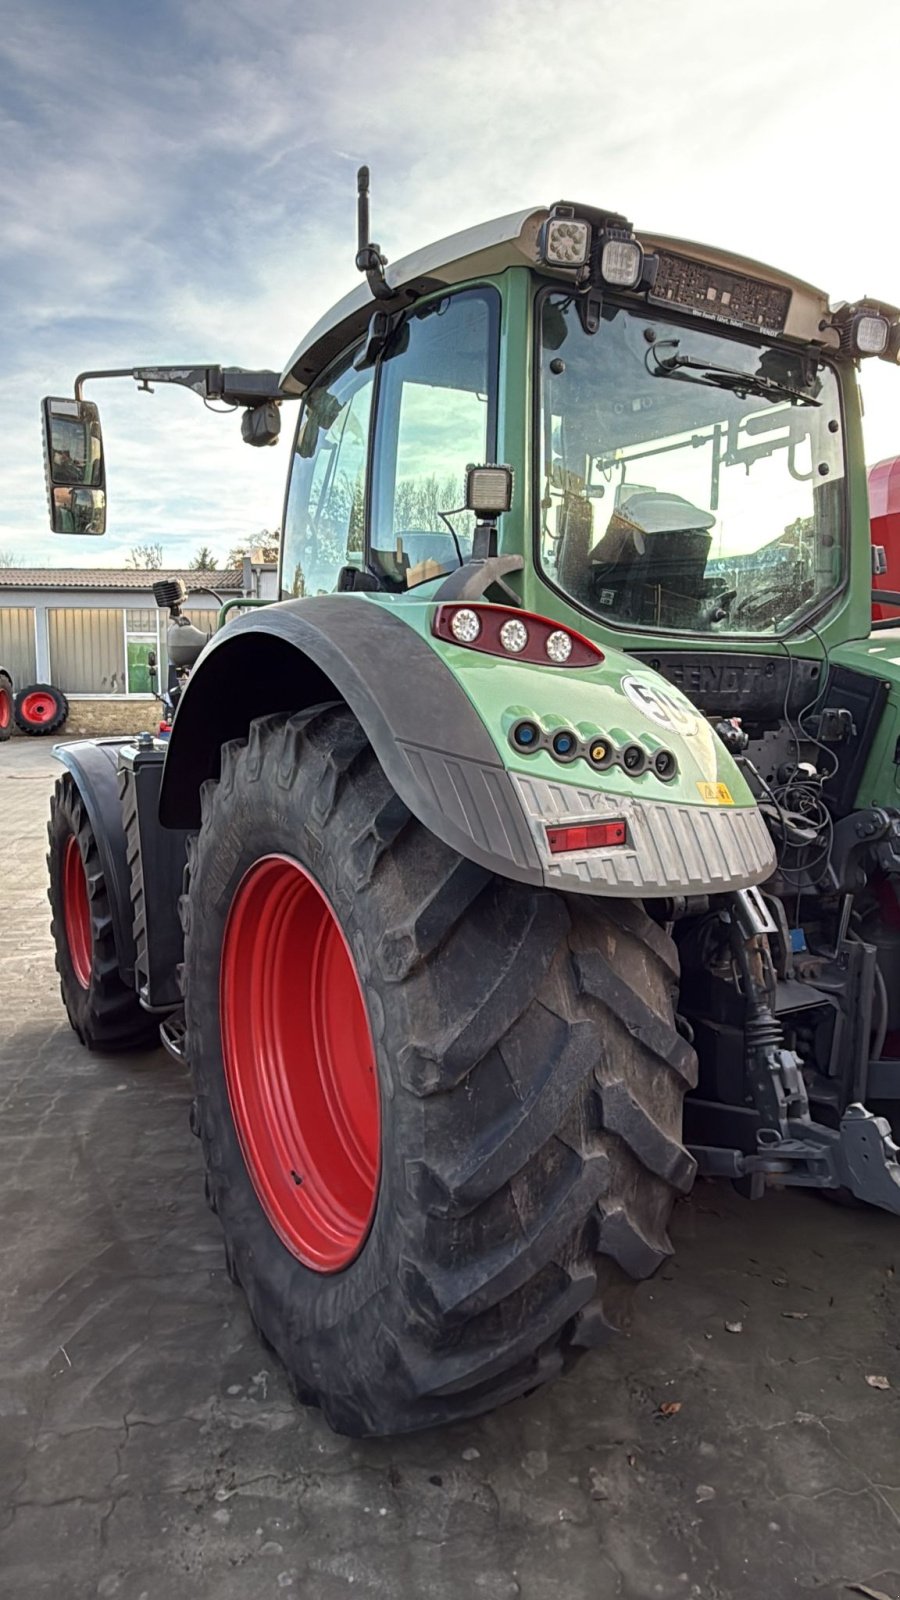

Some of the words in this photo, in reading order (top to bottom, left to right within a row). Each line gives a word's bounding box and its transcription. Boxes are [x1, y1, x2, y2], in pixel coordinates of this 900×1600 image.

[760, 327, 779, 337] FENDT
[665, 664, 761, 693] FENDT
[629, 683, 688, 724] 50
